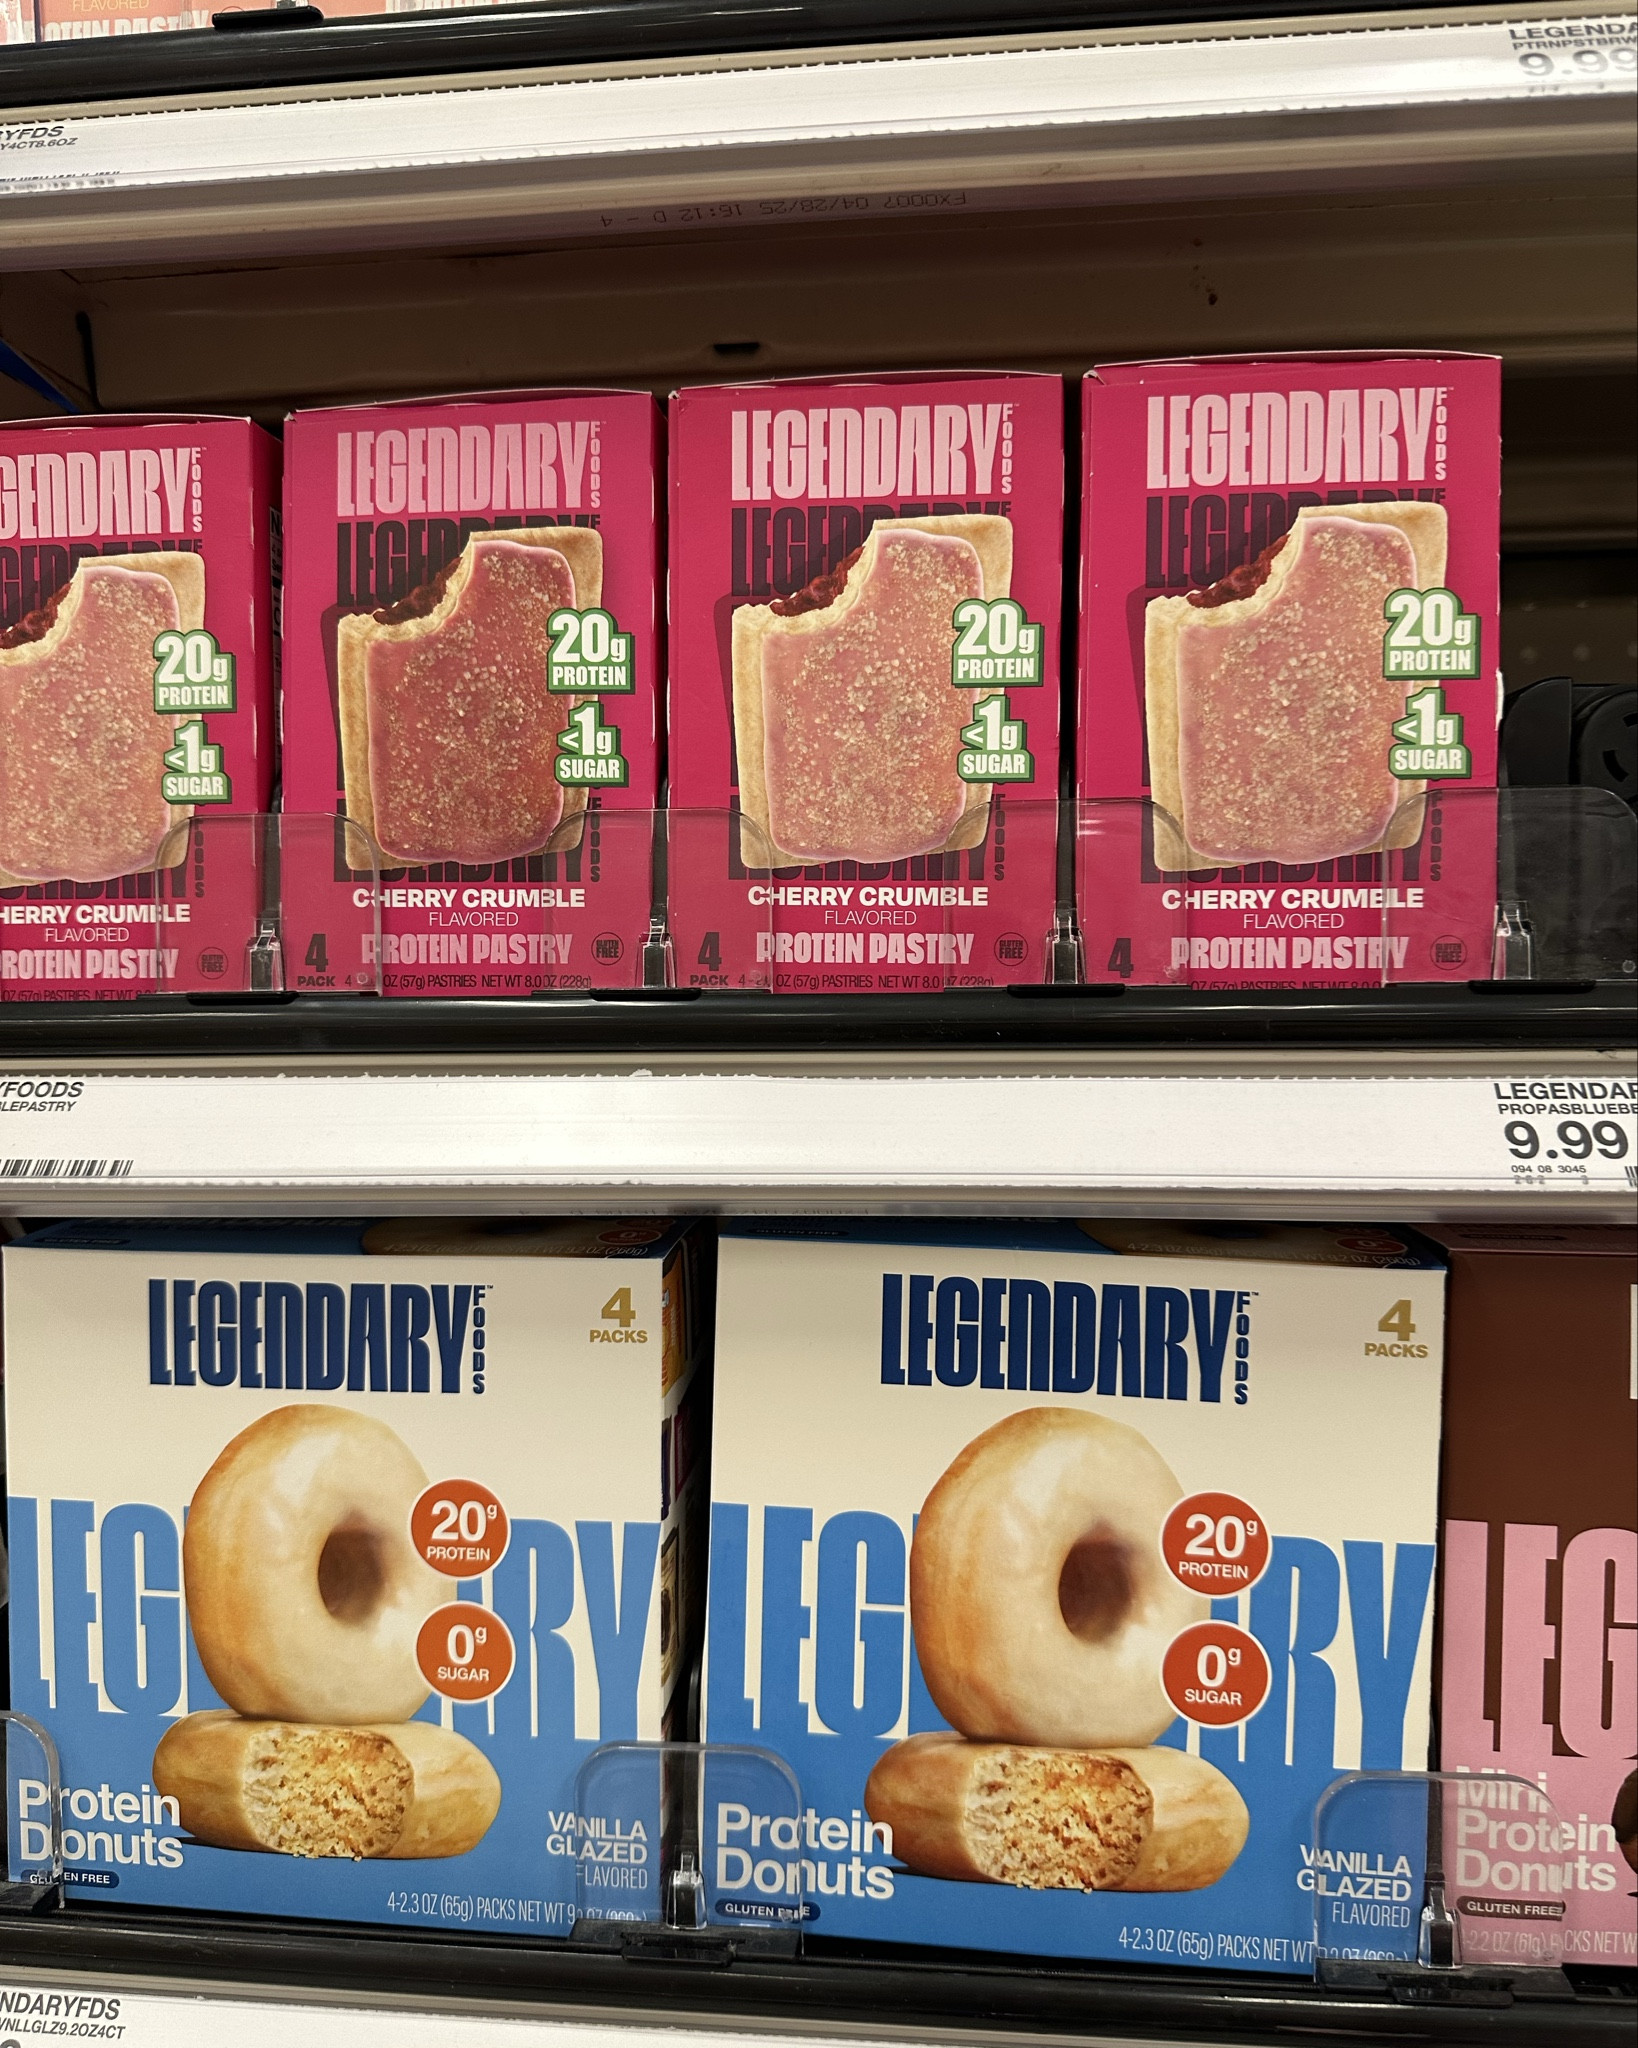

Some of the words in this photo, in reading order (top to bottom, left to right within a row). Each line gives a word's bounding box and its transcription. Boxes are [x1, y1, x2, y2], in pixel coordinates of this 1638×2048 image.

[1518, 48, 1638, 77] 9.99
[678, 203, 743, 222] 16:12
[760, 196, 869, 216] 04/28/25
[1001, 403, 1013, 494] FOODS
[1146, 387, 1436, 490] LEGENDARY
[1435, 387, 1447, 481] FOODS
[590, 421, 601, 508] FOODS
[731, 403, 1002, 501] LEGENDARY
[337, 421, 590, 517] LEGENDARY
[191, 447, 202, 533] FOODS
[957, 604, 1035, 655] 20g
[1389, 594, 1471, 646] 20g
[552, 613, 626, 663] 20g
[158, 634, 228, 684] 20g
[552, 665, 627, 686] PROTEIN
[957, 657, 1035, 679] PROTEIN
[1389, 649, 1471, 671] PROTEIN
[158, 685, 228, 705] PROTEIN
[562, 706, 612, 756] <1g
[965, 700, 1017, 750] <1g
[1398, 693, 1454, 746] <1g
[168, 725, 216, 774] <1g
[962, 753, 1026, 774] SUGAR
[1394, 749, 1462, 771] SUGAR
[559, 758, 620, 779] SUGAR
[166, 776, 224, 796] SUGAR
[353, 887, 457, 909] CHERRY
[461, 887, 586, 909] CRUMBLE
[748, 885, 853, 907] CHERRY
[858, 886, 988, 907] CRUMBLE
[1162, 889, 1275, 910] CHERRY
[1281, 888, 1424, 910] CRUMBLE
[76, 903, 190, 924] CRUMBLE
[428, 911, 519, 928] FLAVORED
[824, 910, 917, 926] FLAVORED
[1243, 913, 1344, 930] FLAVORED
[44, 927, 130, 943] FLAVORED
[361, 933, 469, 965] PROTEIN
[472, 933, 573, 965] PASTRY
[697, 931, 722, 972] 4
[756, 932, 864, 964] PROTEIN
[868, 932, 975, 965] PASTRY
[86, 948, 180, 980] PASTRY
[305, 933, 328, 973] 4
[1107, 937, 1134, 979] 4
[1171, 936, 1286, 969] PROTEIN
[1292, 936, 1410, 969] PASTRY
[297, 975, 336, 988] PACK
[382, 974, 398, 987] OZ
[400, 974, 425, 989] (57g)
[427, 974, 477, 988] PASTRIES
[481, 974, 503, 988] NET
[503, 974, 523, 988] WT
[524, 974, 542, 988] 8.0
[690, 974, 729, 987] PACK
[775, 974, 791, 987] OZ
[793, 974, 819, 989] (57g)
[822, 974, 873, 988] PASTRIES
[878, 974, 900, 988] NET
[901, 974, 921, 988] WT
[922, 974, 940, 988] 8.0
[0, 1101, 77, 1112] LEPASTRY
[1504, 1120, 1629, 1160] 9.99
[1511, 1165, 1533, 1173] 094
[1537, 1165, 1552, 1173] 08
[1557, 1165, 1587, 1173] 3045
[601, 1287, 636, 1328] 4
[1377, 1299, 1416, 1341] 4
[149, 1278, 472, 1394] LEGENDARY
[473, 1285, 486, 1395] FOODS
[589, 1329, 648, 1344] PACKS
[881, 1273, 1236, 1403] LEGENDARY
[1234, 1290, 1251, 1405] FOODS
[1364, 1342, 1428, 1358] PACKS
[431, 1499, 498, 1542] 20g
[1184, 1513, 1258, 1559] 20g
[426, 1546, 491, 1562] PROTEIN
[1178, 1561, 1249, 1580] PROTEIN
[447, 1624, 488, 1665] 0g
[437, 1667, 490, 1682] SUGAR
[1196, 1645, 1242, 1687] 0g
[1184, 1688, 1242, 1706] SUGAR
[19, 1778, 181, 1827] Protein
[548, 1810, 648, 1842] VANILLA
[717, 1802, 894, 1856] Protein
[1456, 1806, 1617, 1854] Protein
[20, 1820, 184, 1869] Donuts
[546, 1833, 648, 1866] GLAZED
[1299, 1844, 1412, 1878] VANILLA
[30, 1872, 78, 1885] GLUEN
[81, 1873, 110, 1884] FREE
[716, 1846, 895, 1900] Donuts
[1296, 1867, 1412, 1903] GLAZED
[1456, 1848, 1617, 1894] Donuts
[387, 1891, 419, 1915] 4-2.3
[421, 1893, 438, 1915] OZ
[440, 1893, 474, 1922] (65g)
[477, 1897, 516, 1922] PACKS
[518, 1900, 541, 1923] NET
[544, 1901, 565, 1925] WT
[724, 1902, 775, 1917] GLUTEN
[1332, 1901, 1411, 1928] FLAVORED
[1466, 1901, 1521, 1915] GLUTEN
[1118, 1926, 1154, 1950] 4-2.3
[1156, 1929, 1175, 1953] OZ
[1177, 1930, 1214, 1960] (65g)
[1217, 1935, 1261, 1959] PACKS
[1262, 1938, 1290, 1962] NET
[1290, 1941, 1315, 1964] WT
[1593, 1931, 1619, 1954] NET
[0, 1991, 121, 2021] NDARYFDS
